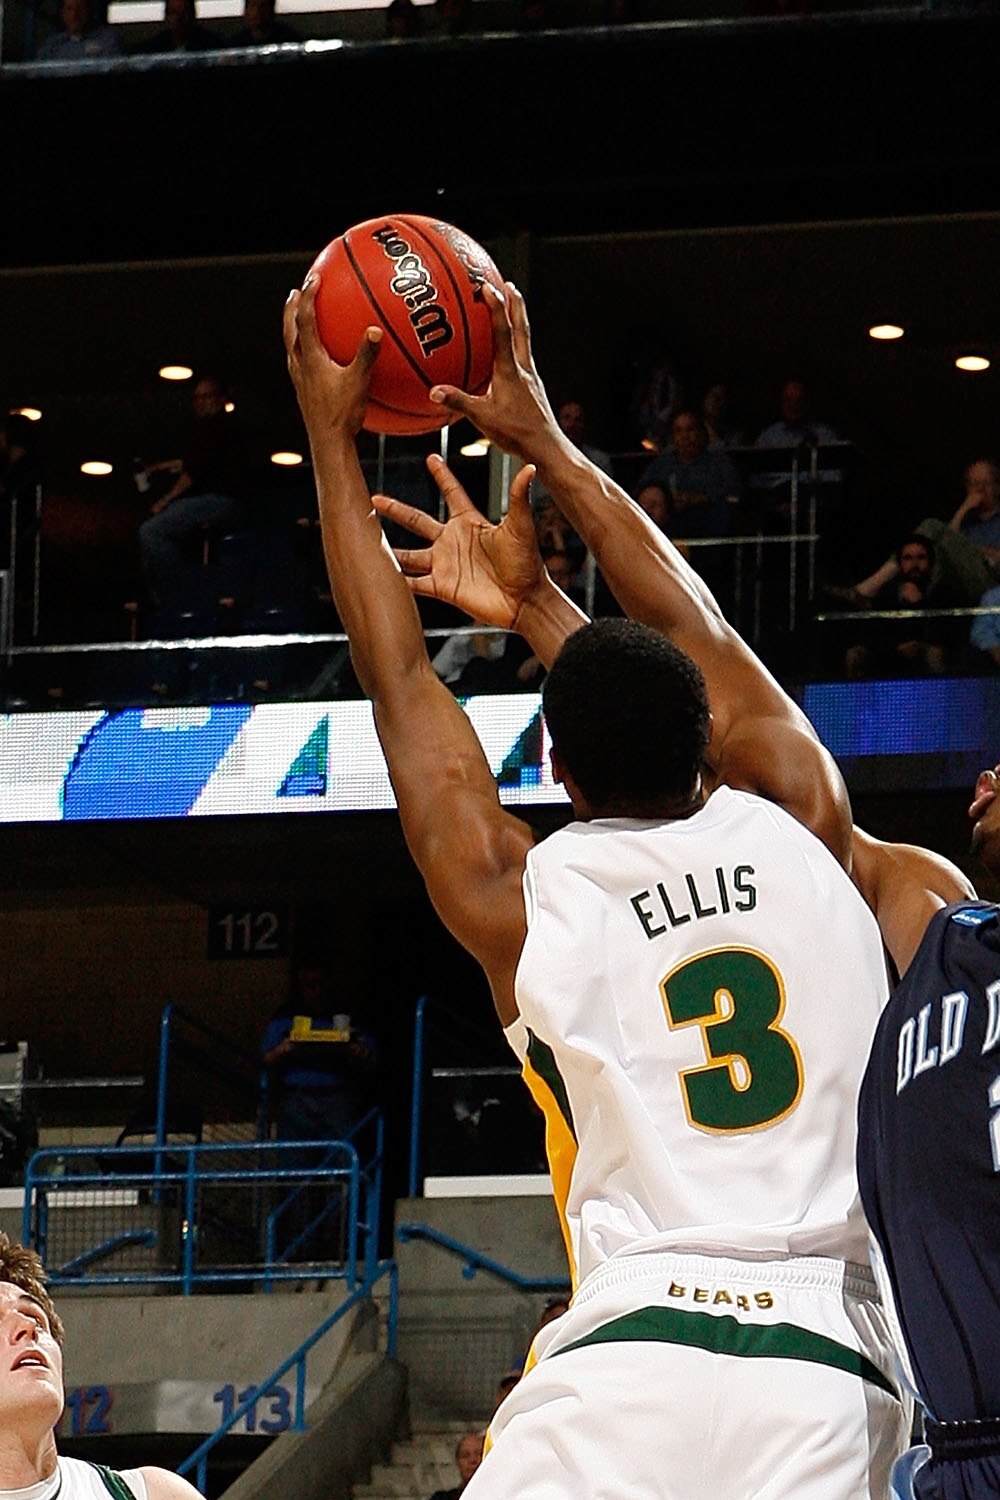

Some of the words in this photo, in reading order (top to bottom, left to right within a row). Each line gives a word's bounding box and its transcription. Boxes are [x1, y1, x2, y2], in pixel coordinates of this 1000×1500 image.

[371, 224, 455, 359] Wilson
[217, 911, 279, 952] 112
[629, 865, 757, 940] ELLIS
[658, 944, 806, 1137] 3
[896, 991, 969, 1095] OLD
[667, 1281, 775, 1312] BEARS
[56, 1384, 114, 1435] 12
[213, 1384, 293, 1433] 113
